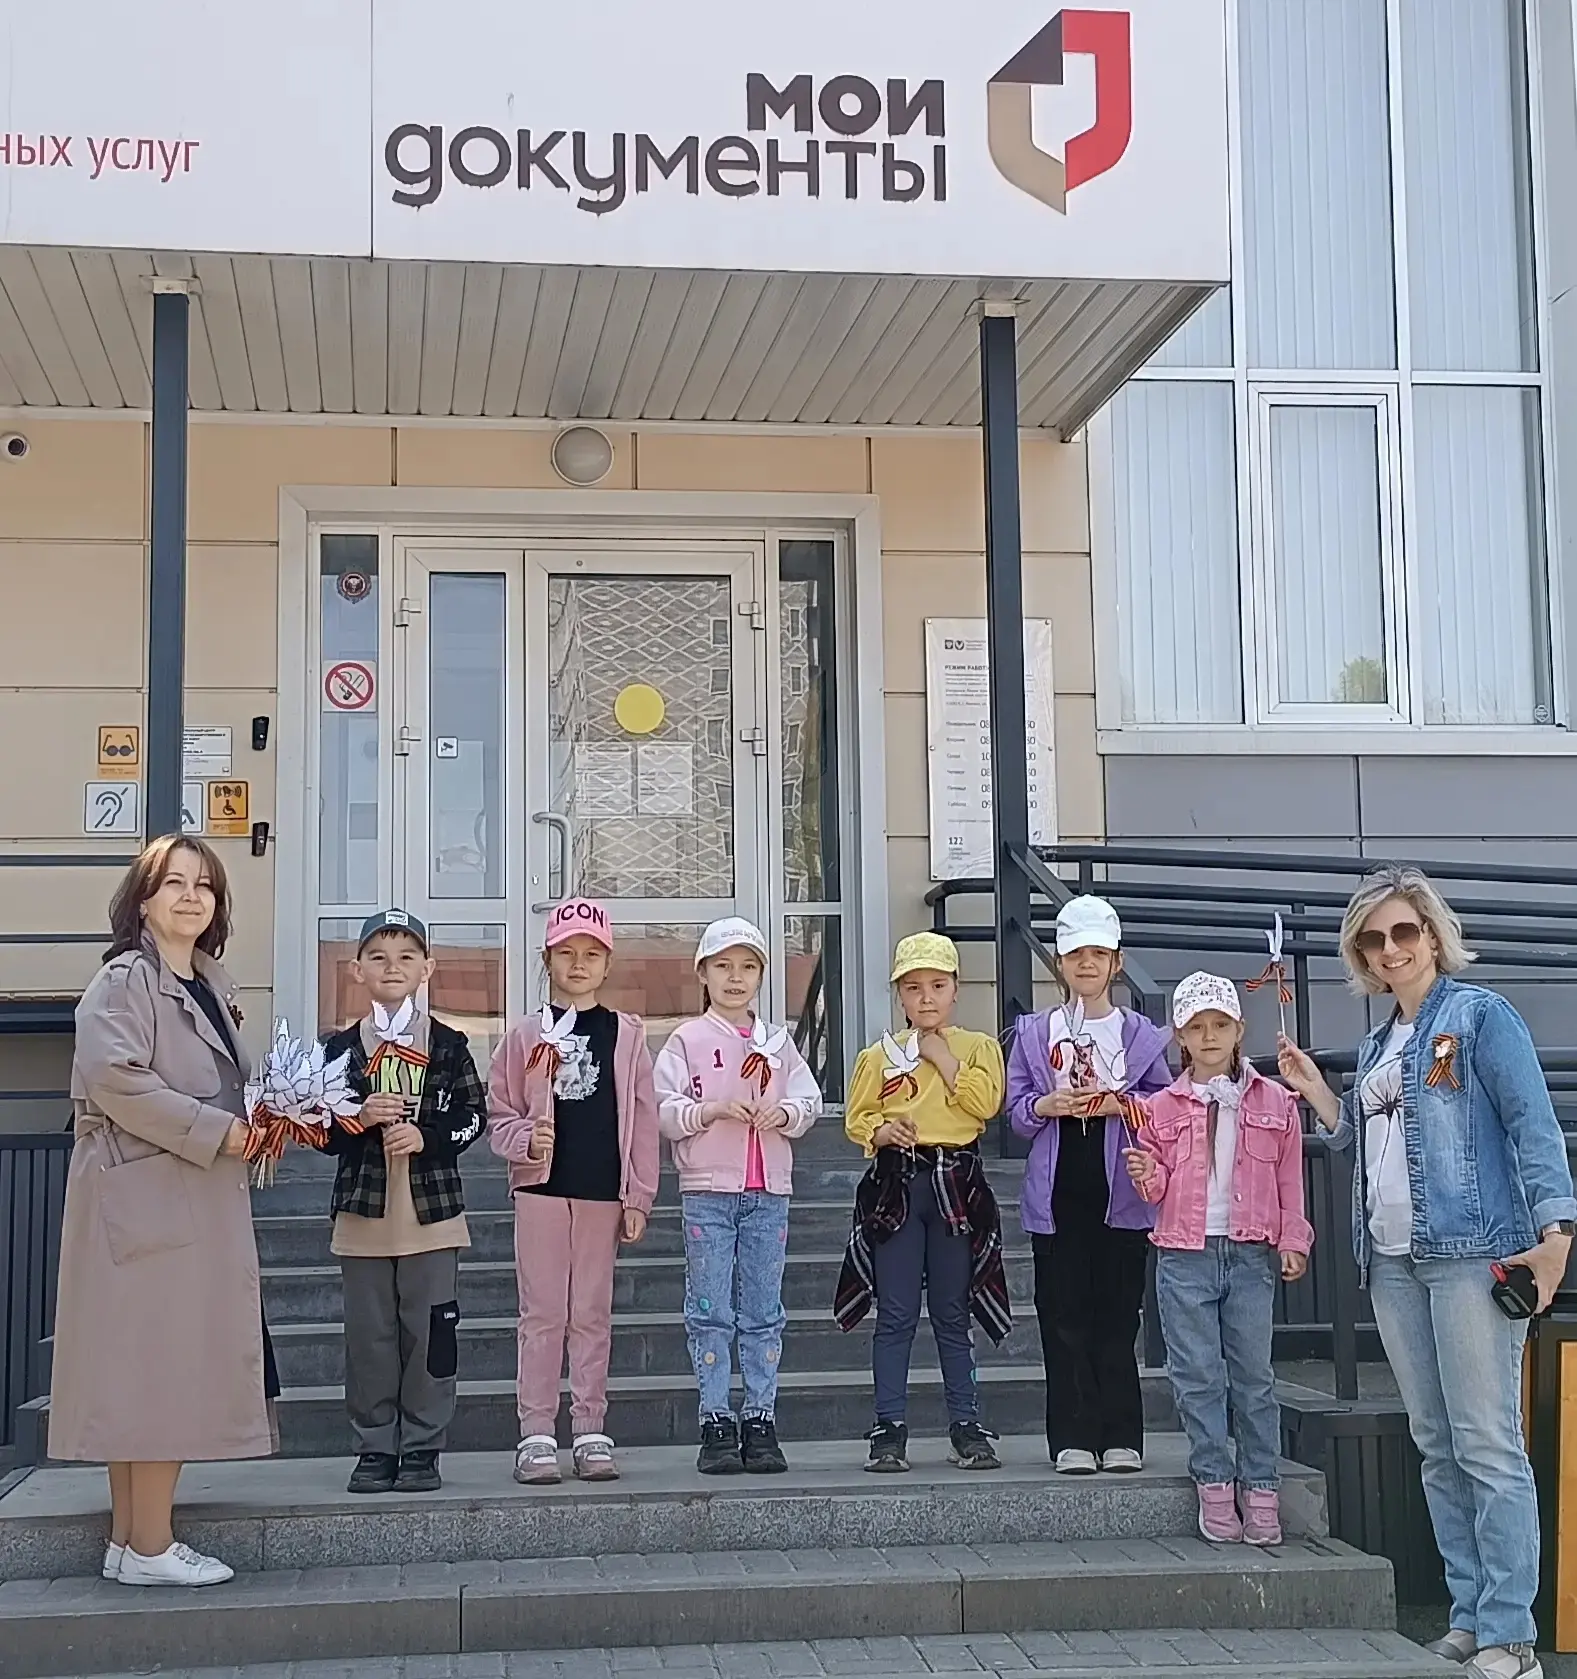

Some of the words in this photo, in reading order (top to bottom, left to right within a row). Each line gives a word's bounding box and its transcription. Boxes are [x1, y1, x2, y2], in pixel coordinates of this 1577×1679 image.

[746, 72, 945, 138] мои
[86, 136, 200, 183] услуг
[384, 122, 946, 214] документы
[948, 836, 964, 846] 122
[556, 903, 604, 928] ICON
[713, 1049, 723, 1068] 1
[692, 1075, 703, 1098] 5
